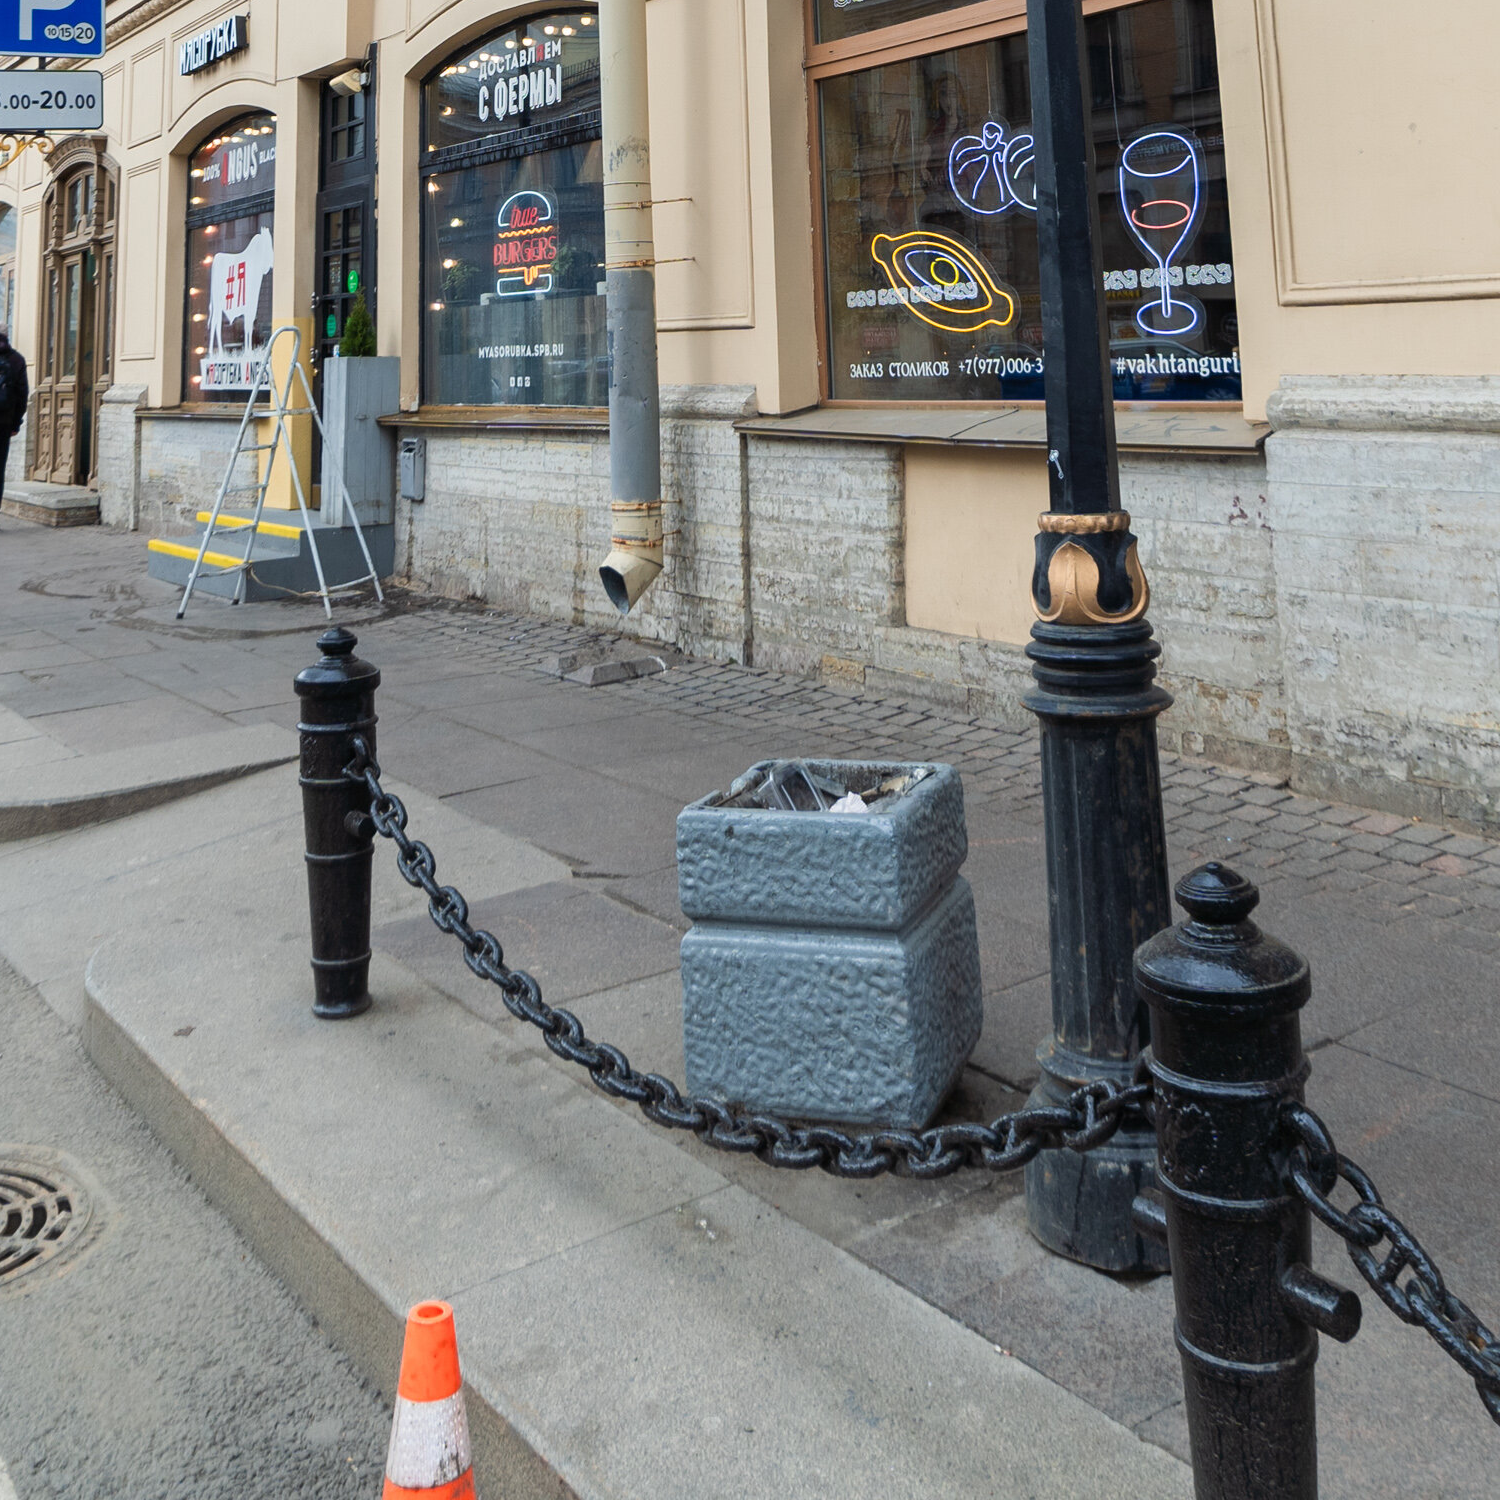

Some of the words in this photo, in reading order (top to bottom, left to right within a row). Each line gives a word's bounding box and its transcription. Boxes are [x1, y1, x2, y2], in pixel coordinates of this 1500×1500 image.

[59, 27, 71, 38] 15
[75, 26, 93, 39] 20
[179, 15, 238, 76] МЯСОРУБКА
[478, 38, 562, 82] ДОСТАВЛЯЕМ
[478, 85, 489, 123] С
[494, 64, 562, 122] ФЕРМЫ
[221, 141, 259, 187] ANGUS
[493, 235, 557, 266] BURGERS
[478, 343, 564, 359] MYASORUBKA.SPB.RU
[1116, 351, 1240, 377] #vakhtanguri
[850, 363, 884, 378] ЗАКАЗ
[888, 361, 949, 378] СТОЛИКОВ
